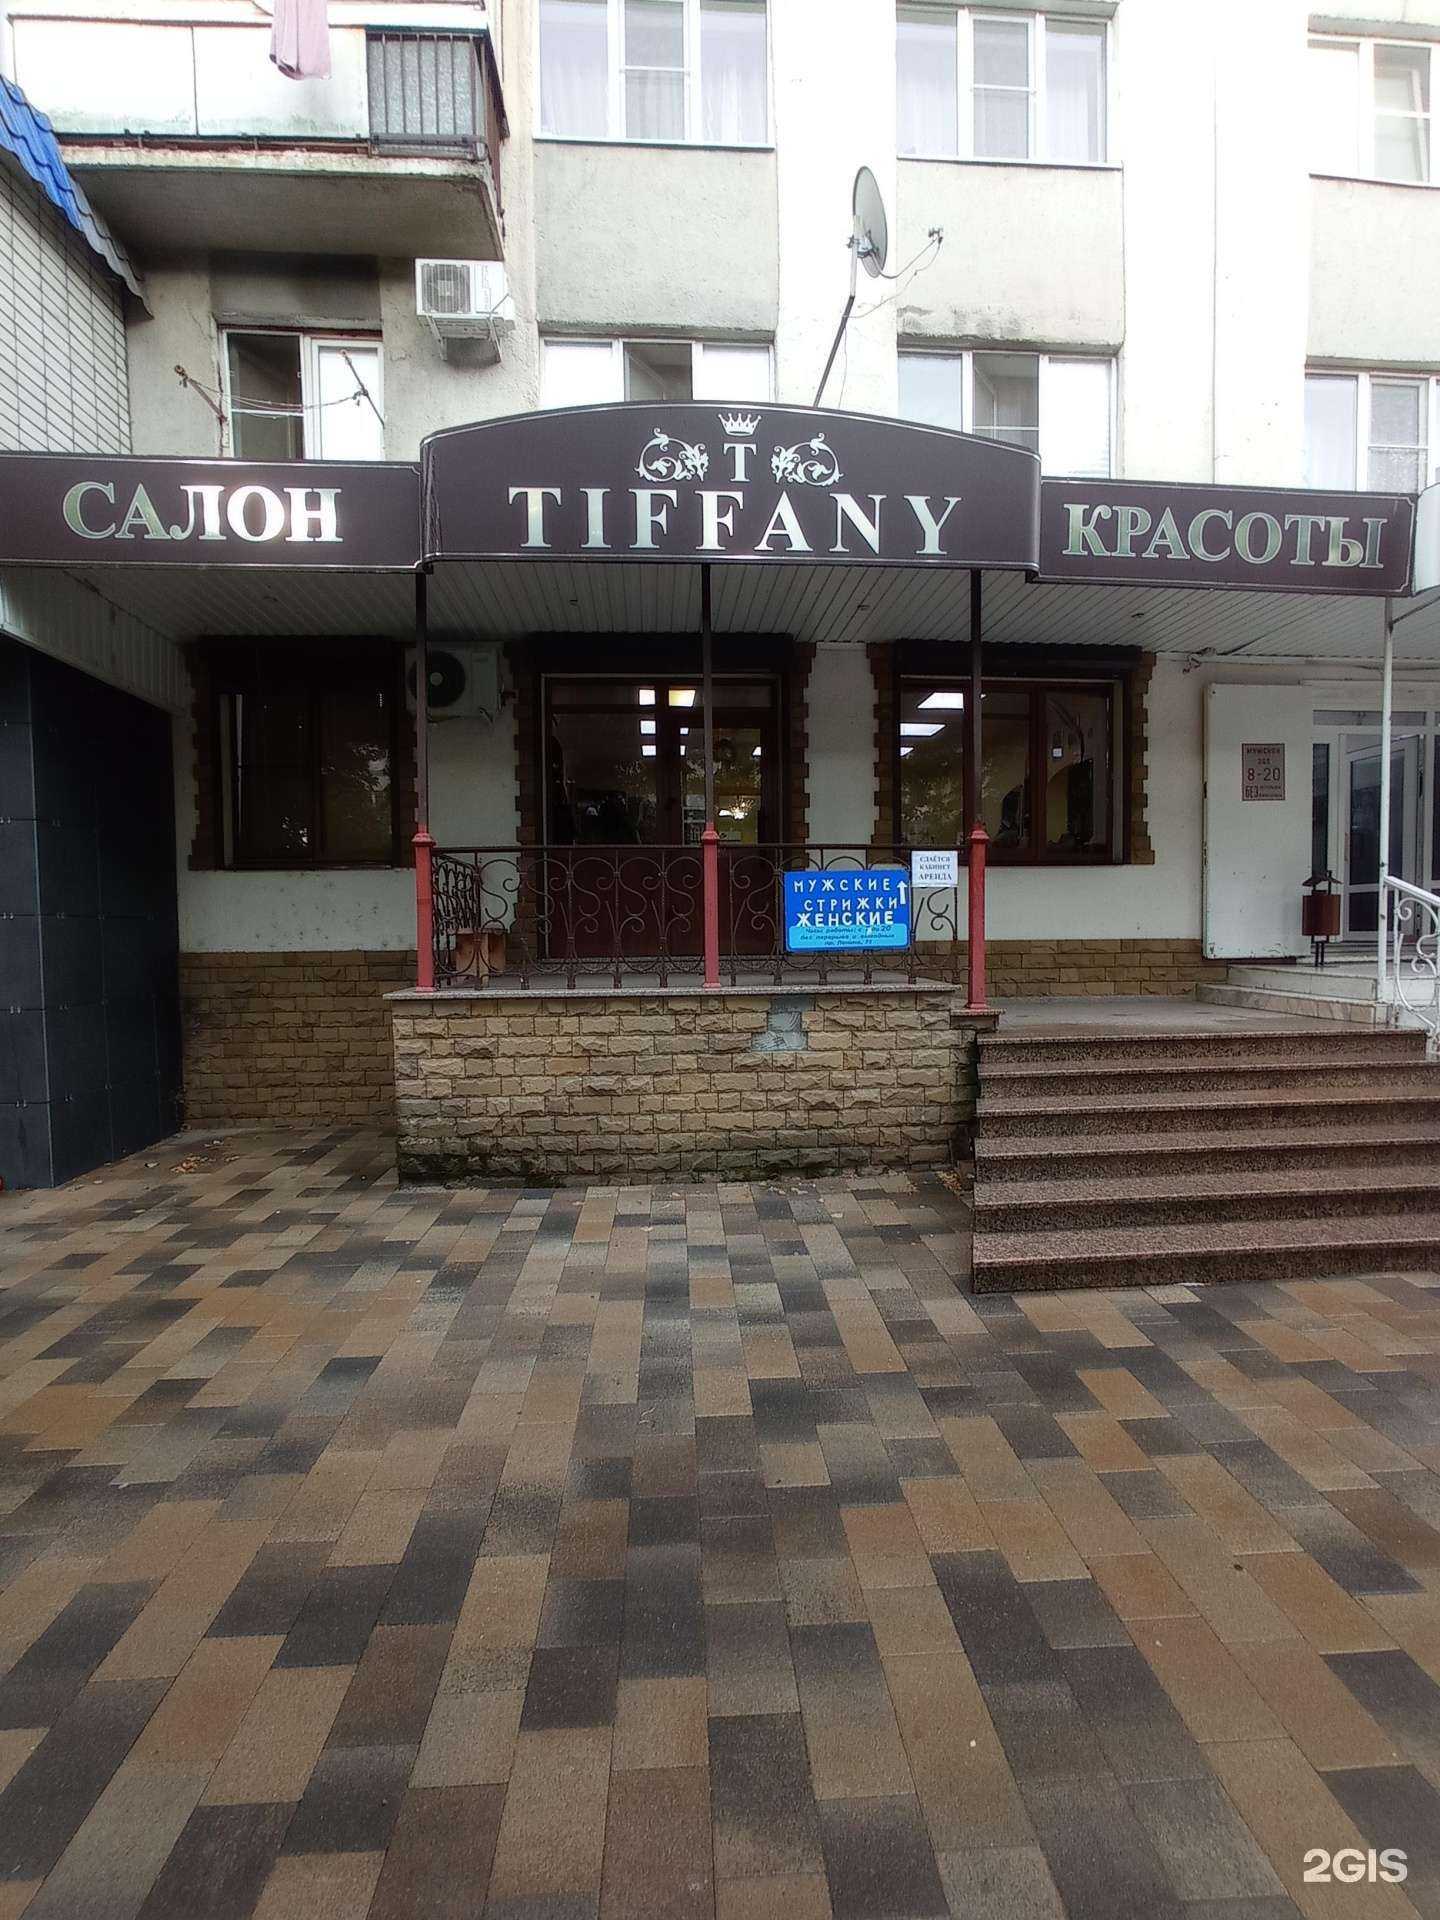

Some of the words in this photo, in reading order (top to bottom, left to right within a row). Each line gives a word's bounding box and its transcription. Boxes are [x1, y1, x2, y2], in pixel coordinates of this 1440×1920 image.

[723, 443, 757, 484] T
[62, 480, 344, 543] САЛОН
[508, 486, 962, 556] TIFFANY
[1062, 502, 1389, 569] КРАСОТЫ
[794, 878, 891, 893] МУЖСКИЕ
[919, 873, 952, 881] АРЕНДА
[795, 910, 894, 928] ЖЕНСКИЕ
[804, 897, 898, 912] СТРИЖКИ
